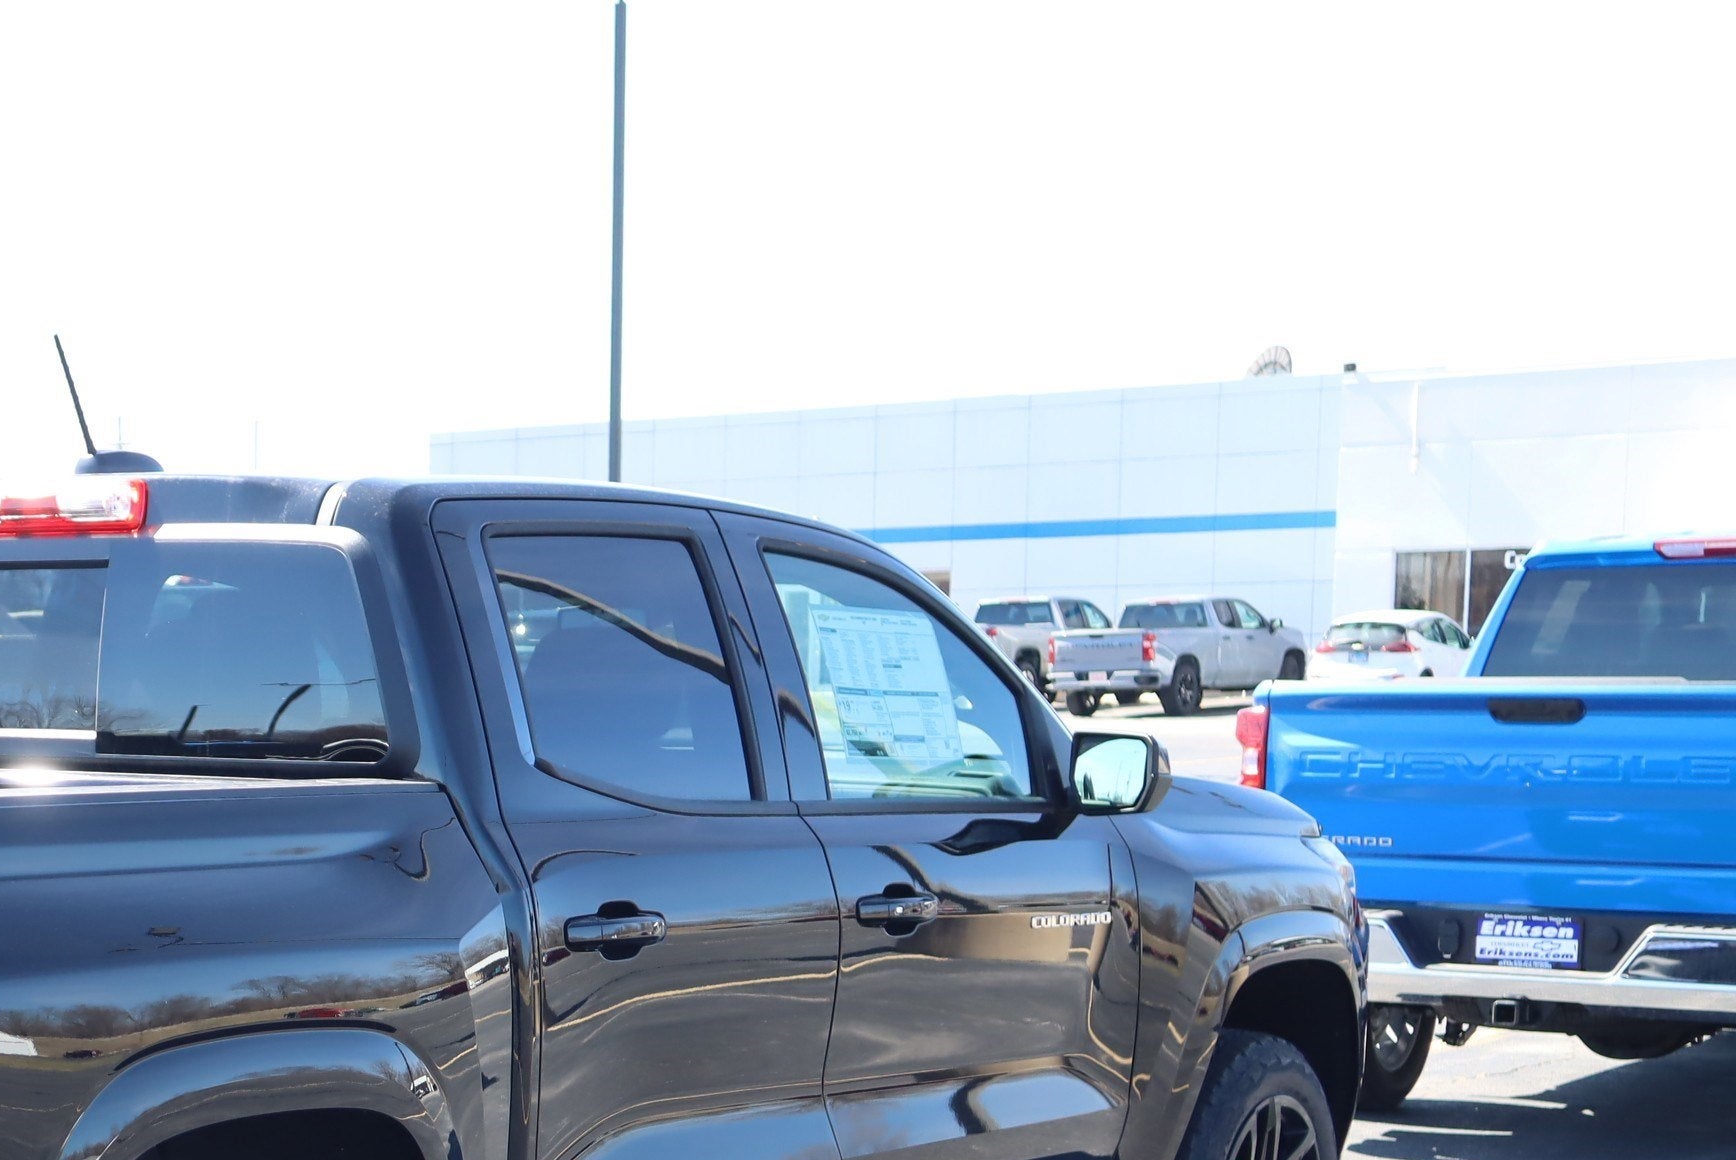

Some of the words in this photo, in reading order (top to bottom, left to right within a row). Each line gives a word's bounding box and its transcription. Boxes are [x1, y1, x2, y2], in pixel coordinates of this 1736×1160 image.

[1322, 835, 1393, 847] RADO
[1031, 911, 1112, 929] COLORADO
[1480, 920, 1574, 939] Eriksen
[1479, 947, 1574, 960] Eriksens.com
